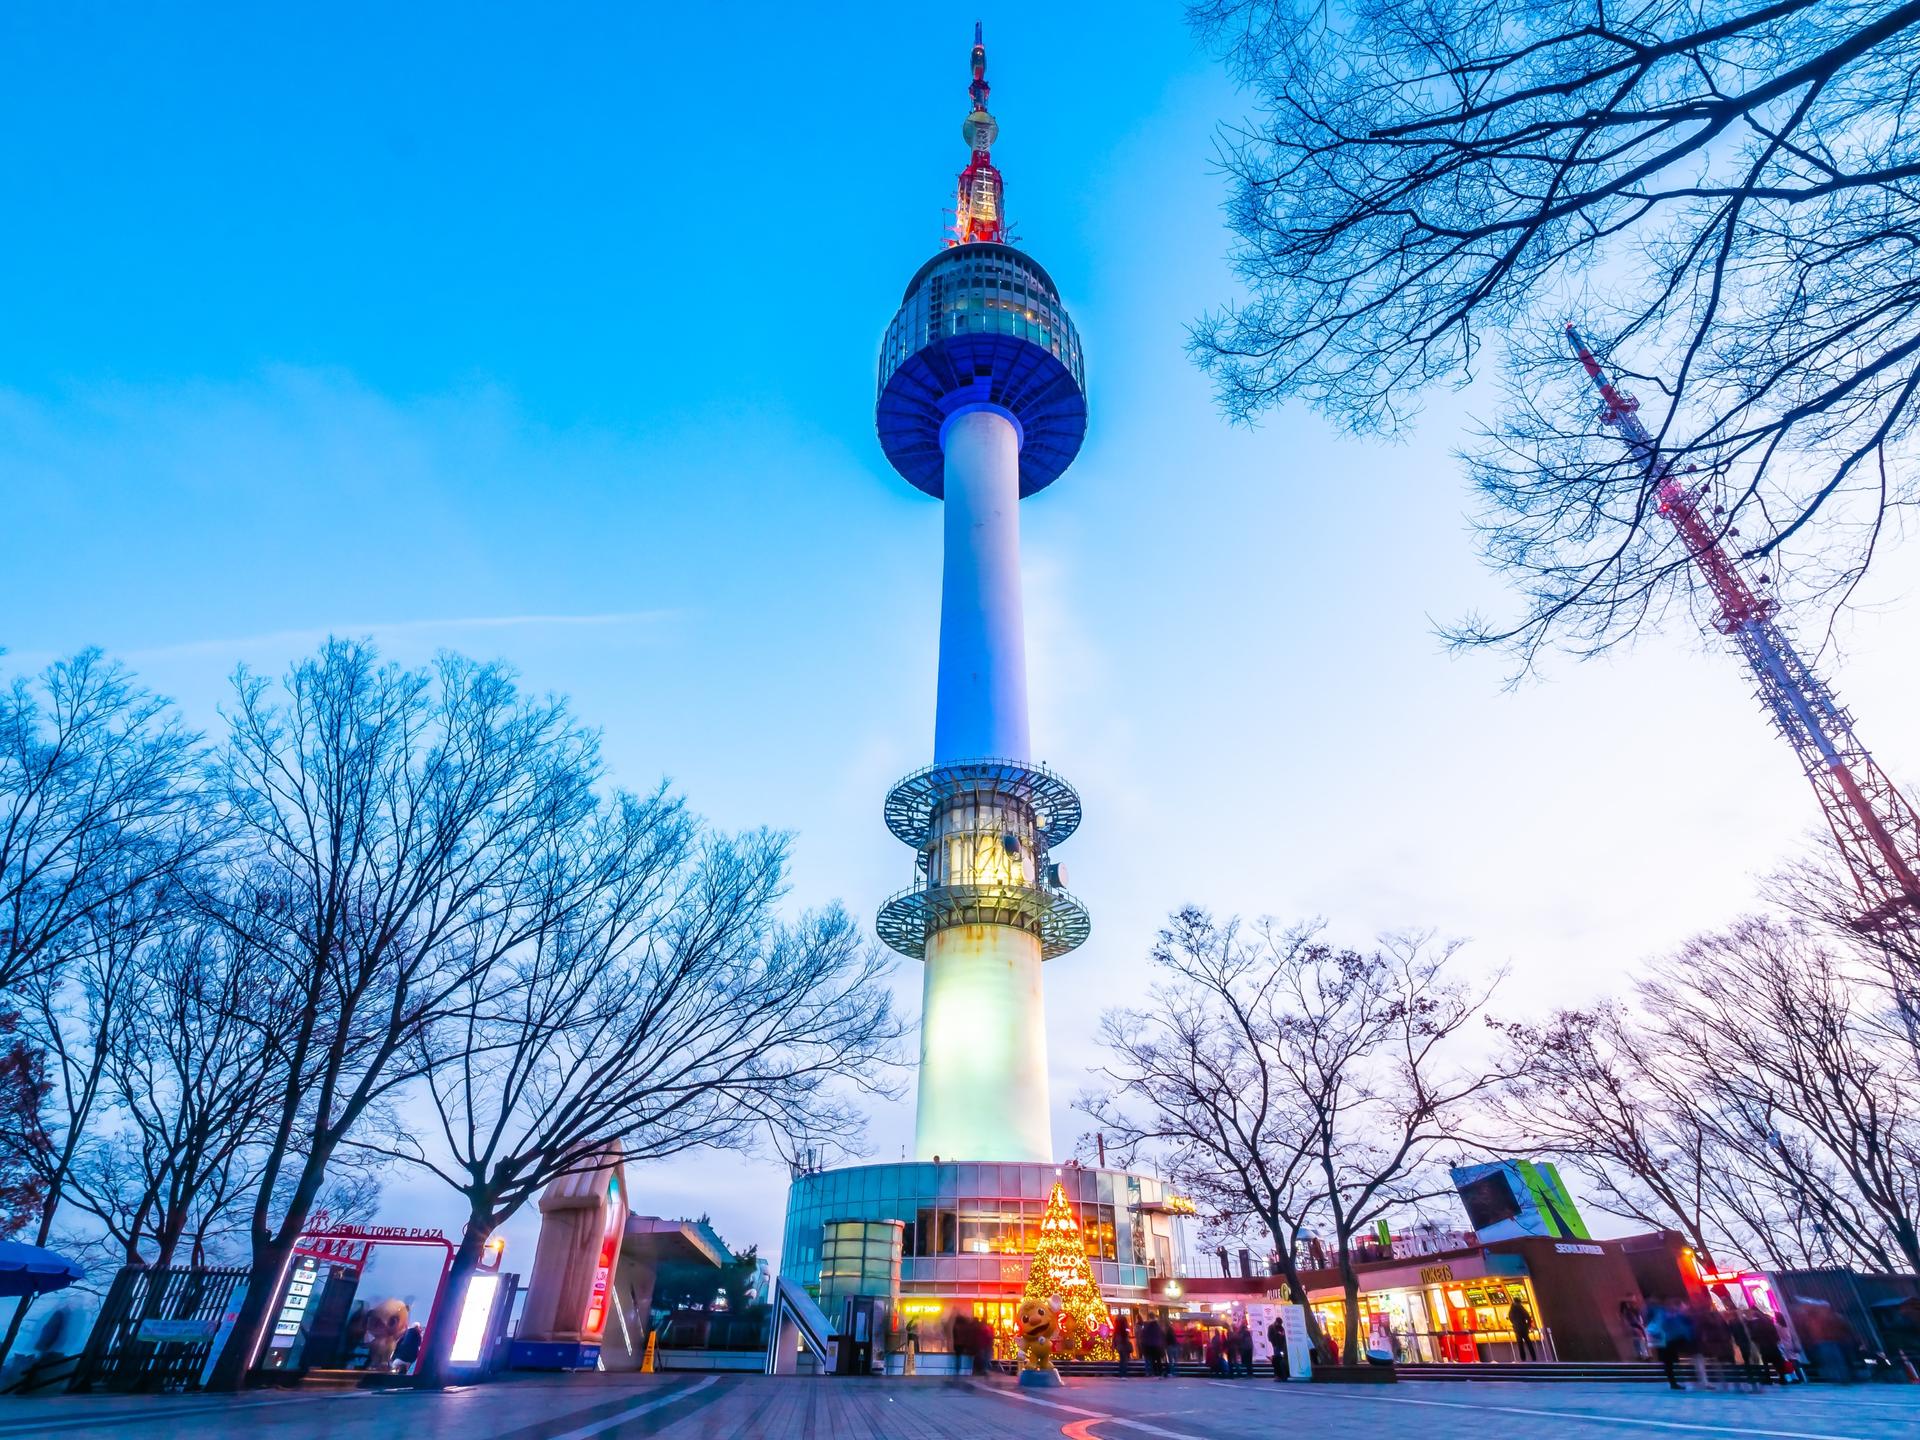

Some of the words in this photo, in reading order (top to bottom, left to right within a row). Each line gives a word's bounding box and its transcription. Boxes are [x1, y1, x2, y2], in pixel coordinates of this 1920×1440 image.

[332, 1225, 367, 1236] SEOUL
[370, 1226, 407, 1237] TOWER
[410, 1229, 444, 1239] PLAZA
[1049, 1254, 1087, 1267] KLOOK
